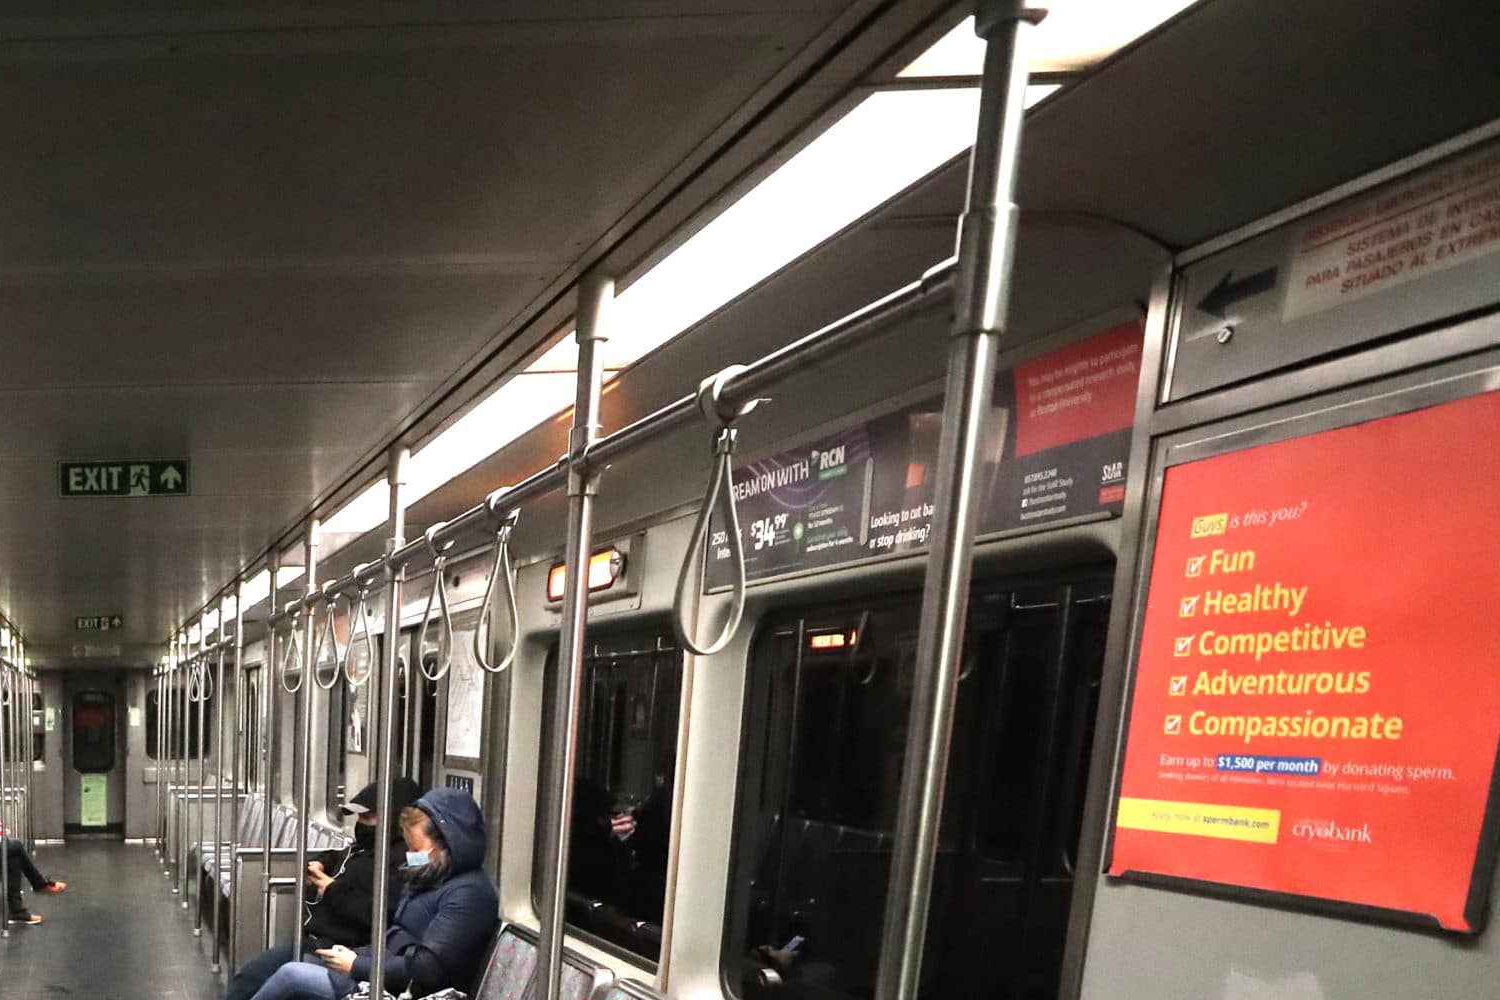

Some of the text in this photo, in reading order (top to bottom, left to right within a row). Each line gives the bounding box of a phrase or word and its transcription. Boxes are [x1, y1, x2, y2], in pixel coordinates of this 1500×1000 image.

[1306, 267, 1340, 288] PARA
[1346, 231, 1434, 273] PASAJEROS
[1470, 207, 1500, 228] CAS
[1340, 260, 1404, 293] SITUADO
[68, 467, 123, 491] EXIT
[733, 482, 760, 502] REAM
[761, 471, 775, 492] ON
[776, 460, 809, 487] WITH
[819, 445, 846, 470] RCN
[871, 502, 934, 529] Looking to cut ba
[1229, 516, 1240, 529] is
[1243, 510, 1267, 527] this
[1270, 501, 1308, 527] you?
[877, 533, 894, 549] stop
[895, 524, 931, 543] drinking?
[717, 546, 731, 560] Inte
[1209, 549, 1256, 575] Fun
[1203, 582, 1307, 616] Healthy
[77, 618, 98, 629] EXIT
[1198, 621, 1367, 661] Competitive
[1192, 669, 1371, 696] Adventurous
[1189, 709, 1403, 744] Compassionate
[1159, 754, 1456, 781] Earn up to $1,500 per month by donating sperm.
[1203, 815, 1269, 829] spermbank.com
[1292, 820, 1372, 843] cryobank
